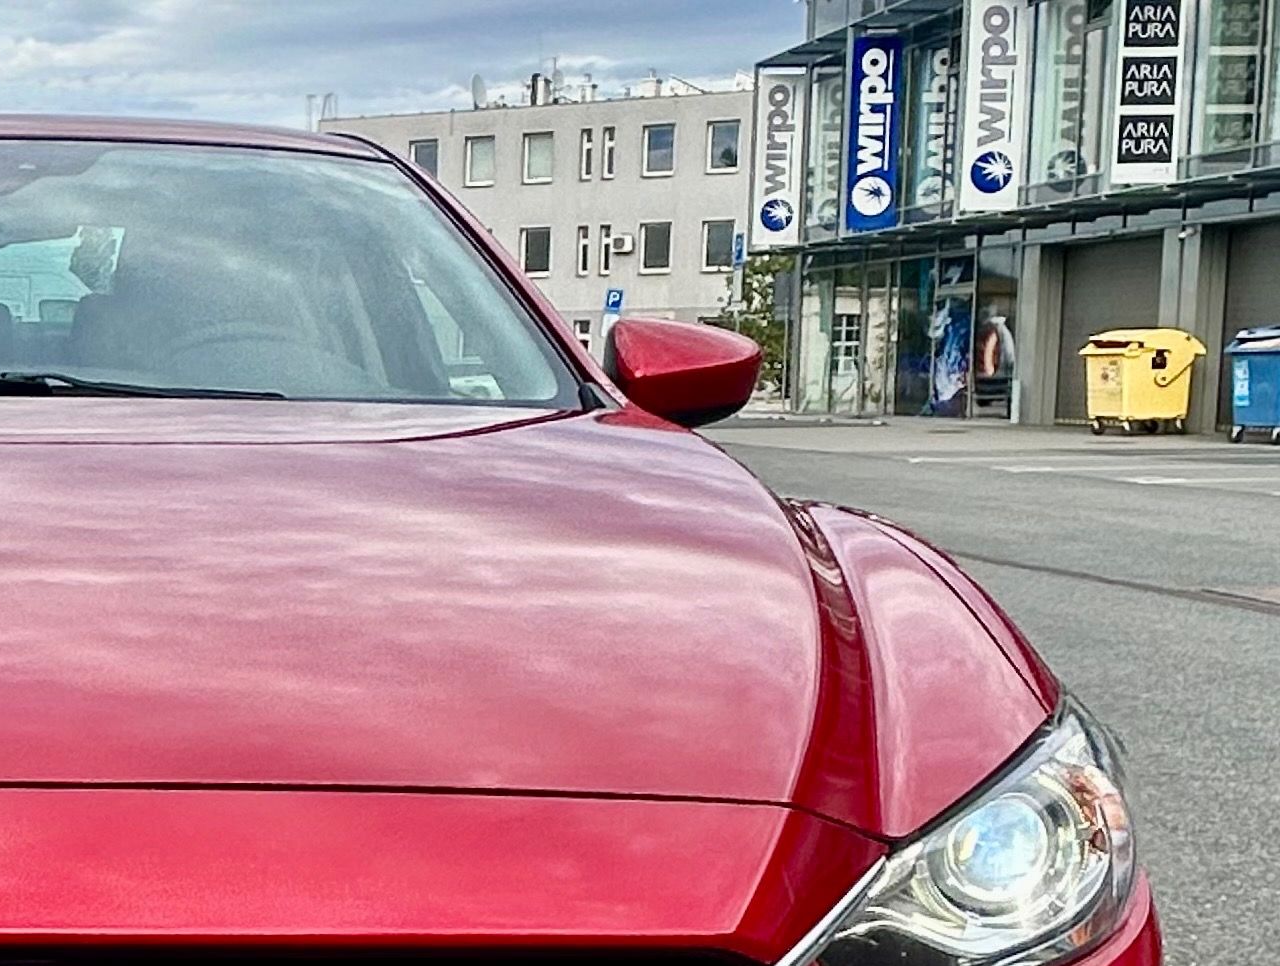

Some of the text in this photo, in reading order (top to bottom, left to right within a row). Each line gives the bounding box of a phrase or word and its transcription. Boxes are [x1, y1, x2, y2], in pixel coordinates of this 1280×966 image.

[1129, 5, 1176, 21] ARIA
[1128, 22, 1175, 38] PURA
[977, 5, 1017, 147] wirpo
[1125, 64, 1172, 79] ARIA
[1124, 81, 1171, 96] PURA
[857, 48, 894, 176] wirpo
[1122, 122, 1169, 137] ARIA
[764, 84, 796, 196] wirpo
[1121, 138, 1168, 154] PURA
[609, 291, 620, 306] P
